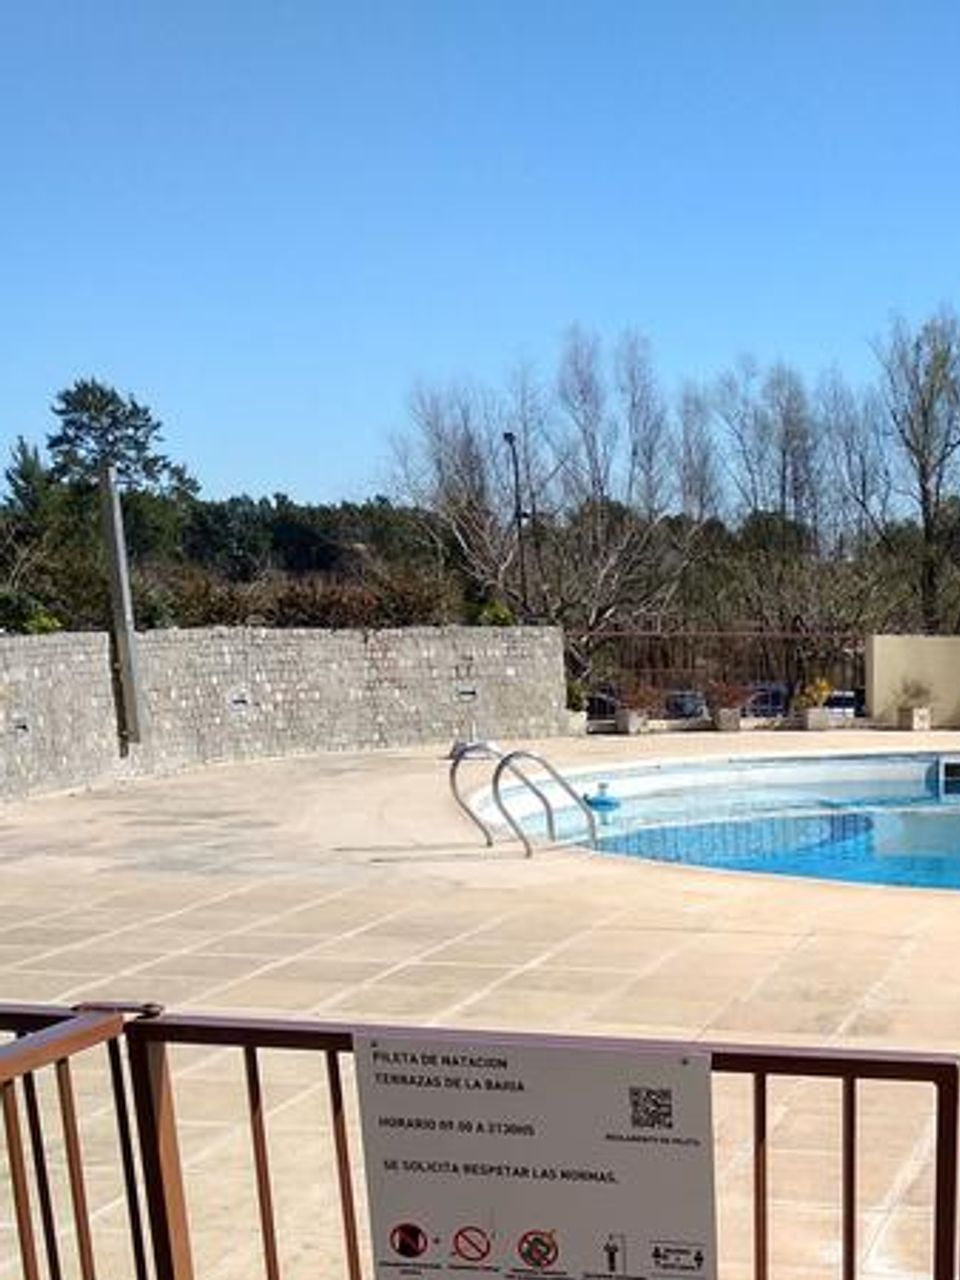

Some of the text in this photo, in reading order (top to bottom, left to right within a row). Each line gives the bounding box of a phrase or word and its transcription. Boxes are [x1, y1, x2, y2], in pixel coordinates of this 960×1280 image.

[421, 1054, 437, 1066] DE
[384, 1160, 399, 1171] SE
[402, 1160, 460, 1174] SOLICITA
[462, 1163, 530, 1179] RESPETAR
[532, 1167, 558, 1180] LAS
